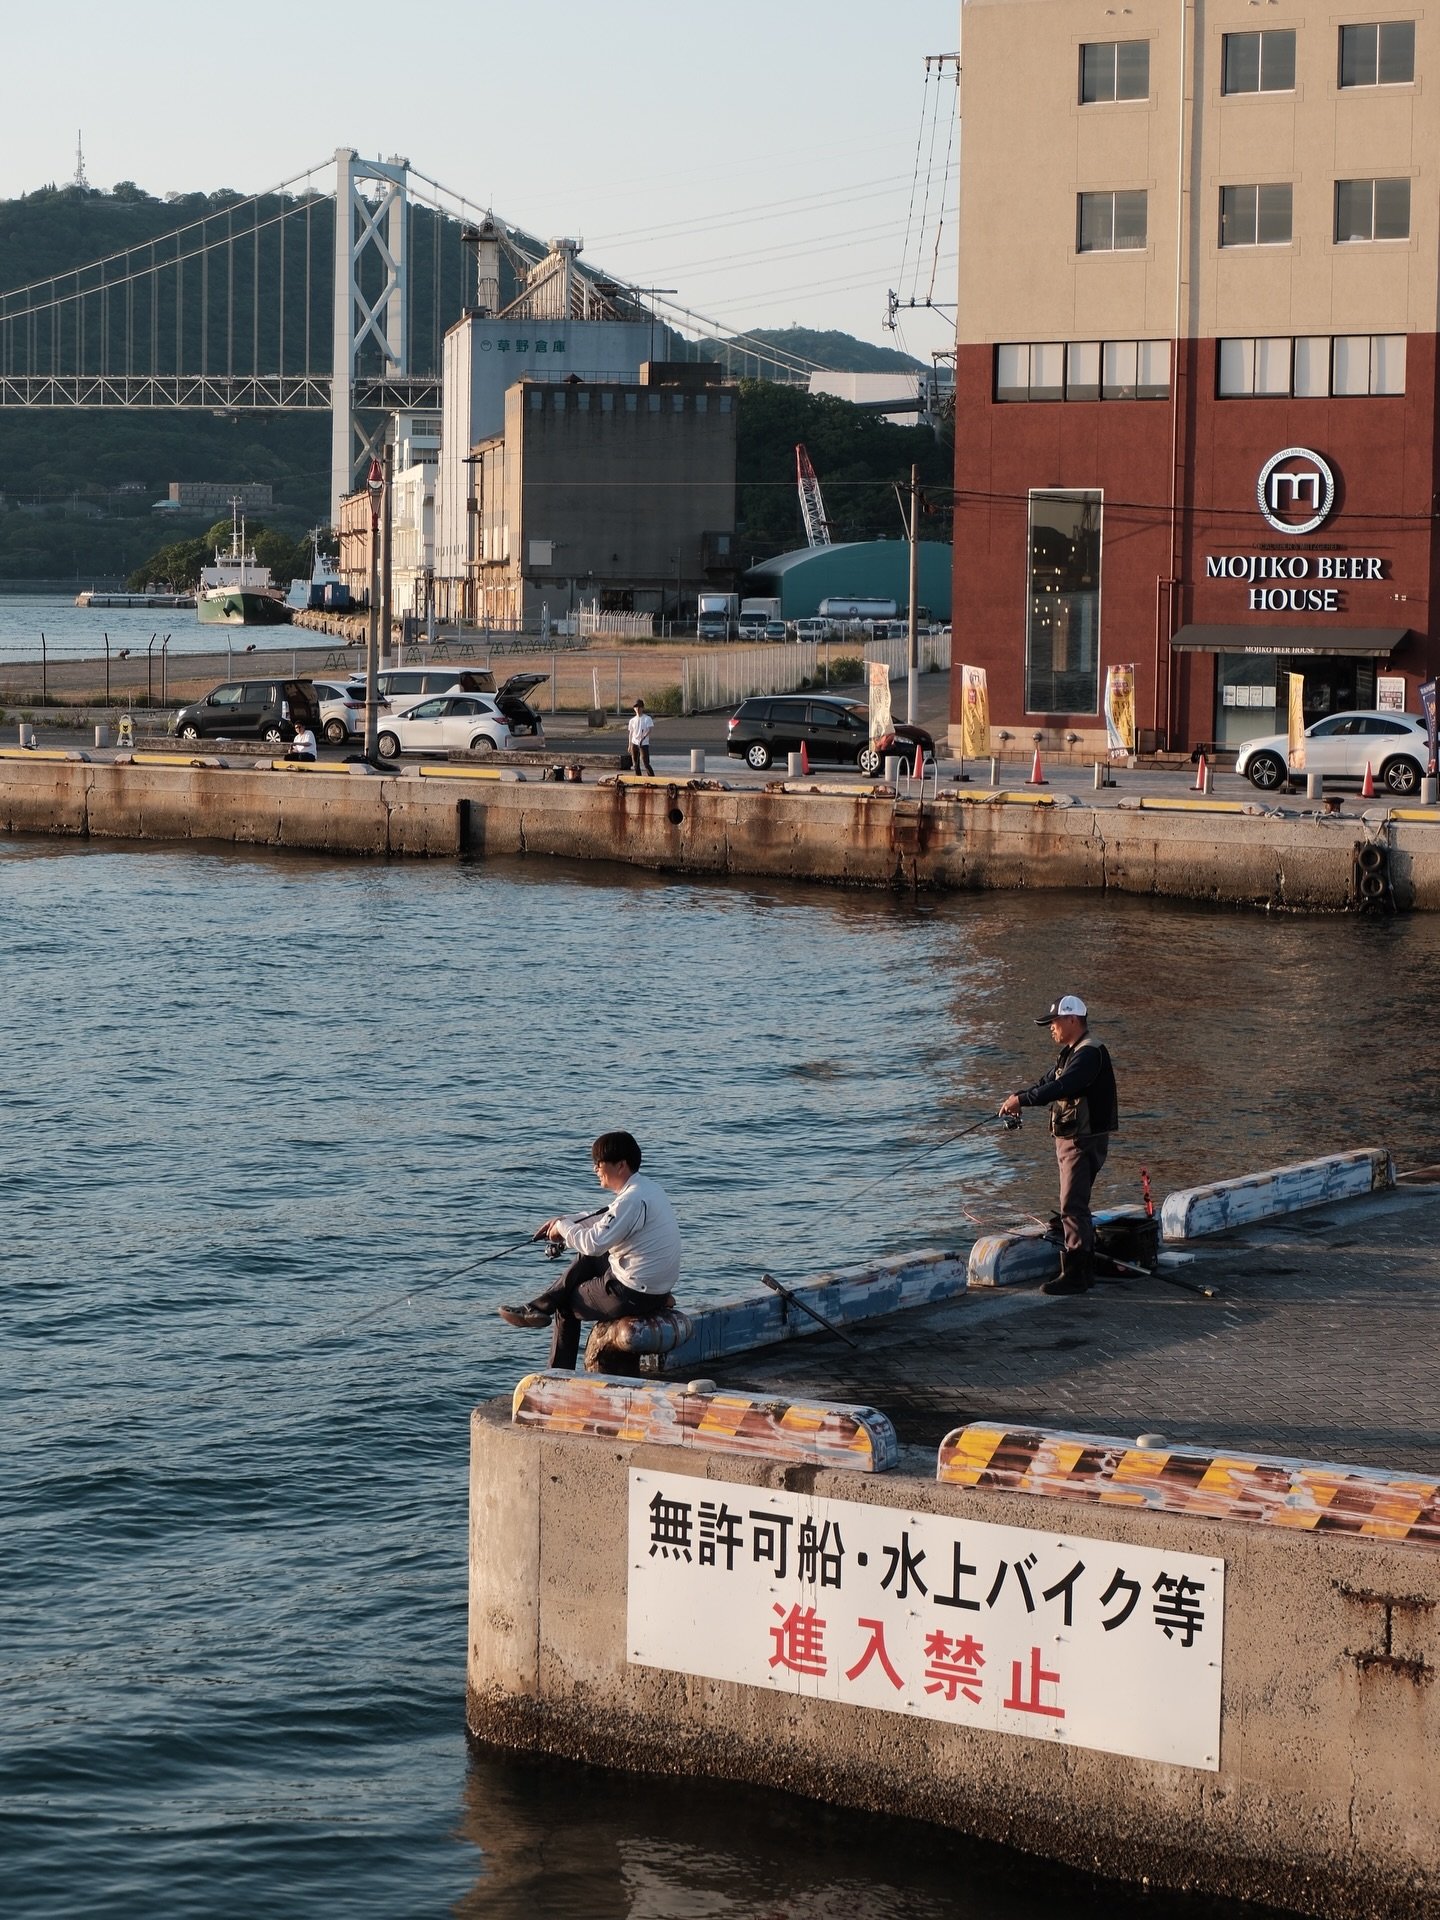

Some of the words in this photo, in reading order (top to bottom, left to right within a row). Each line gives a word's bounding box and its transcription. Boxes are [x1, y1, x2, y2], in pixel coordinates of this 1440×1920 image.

[497, 340, 566, 352] 草野倉庫
[1206, 556, 1309, 583] MOJIKO
[1317, 557, 1384, 580] BEER
[1249, 588, 1339, 612] HOUSE
[1245, 646, 1272, 654] MOJIKO
[650, 1491, 1204, 1647] 無許可船・水上バイク等
[769, 1603, 1064, 1718] 進入禁止
